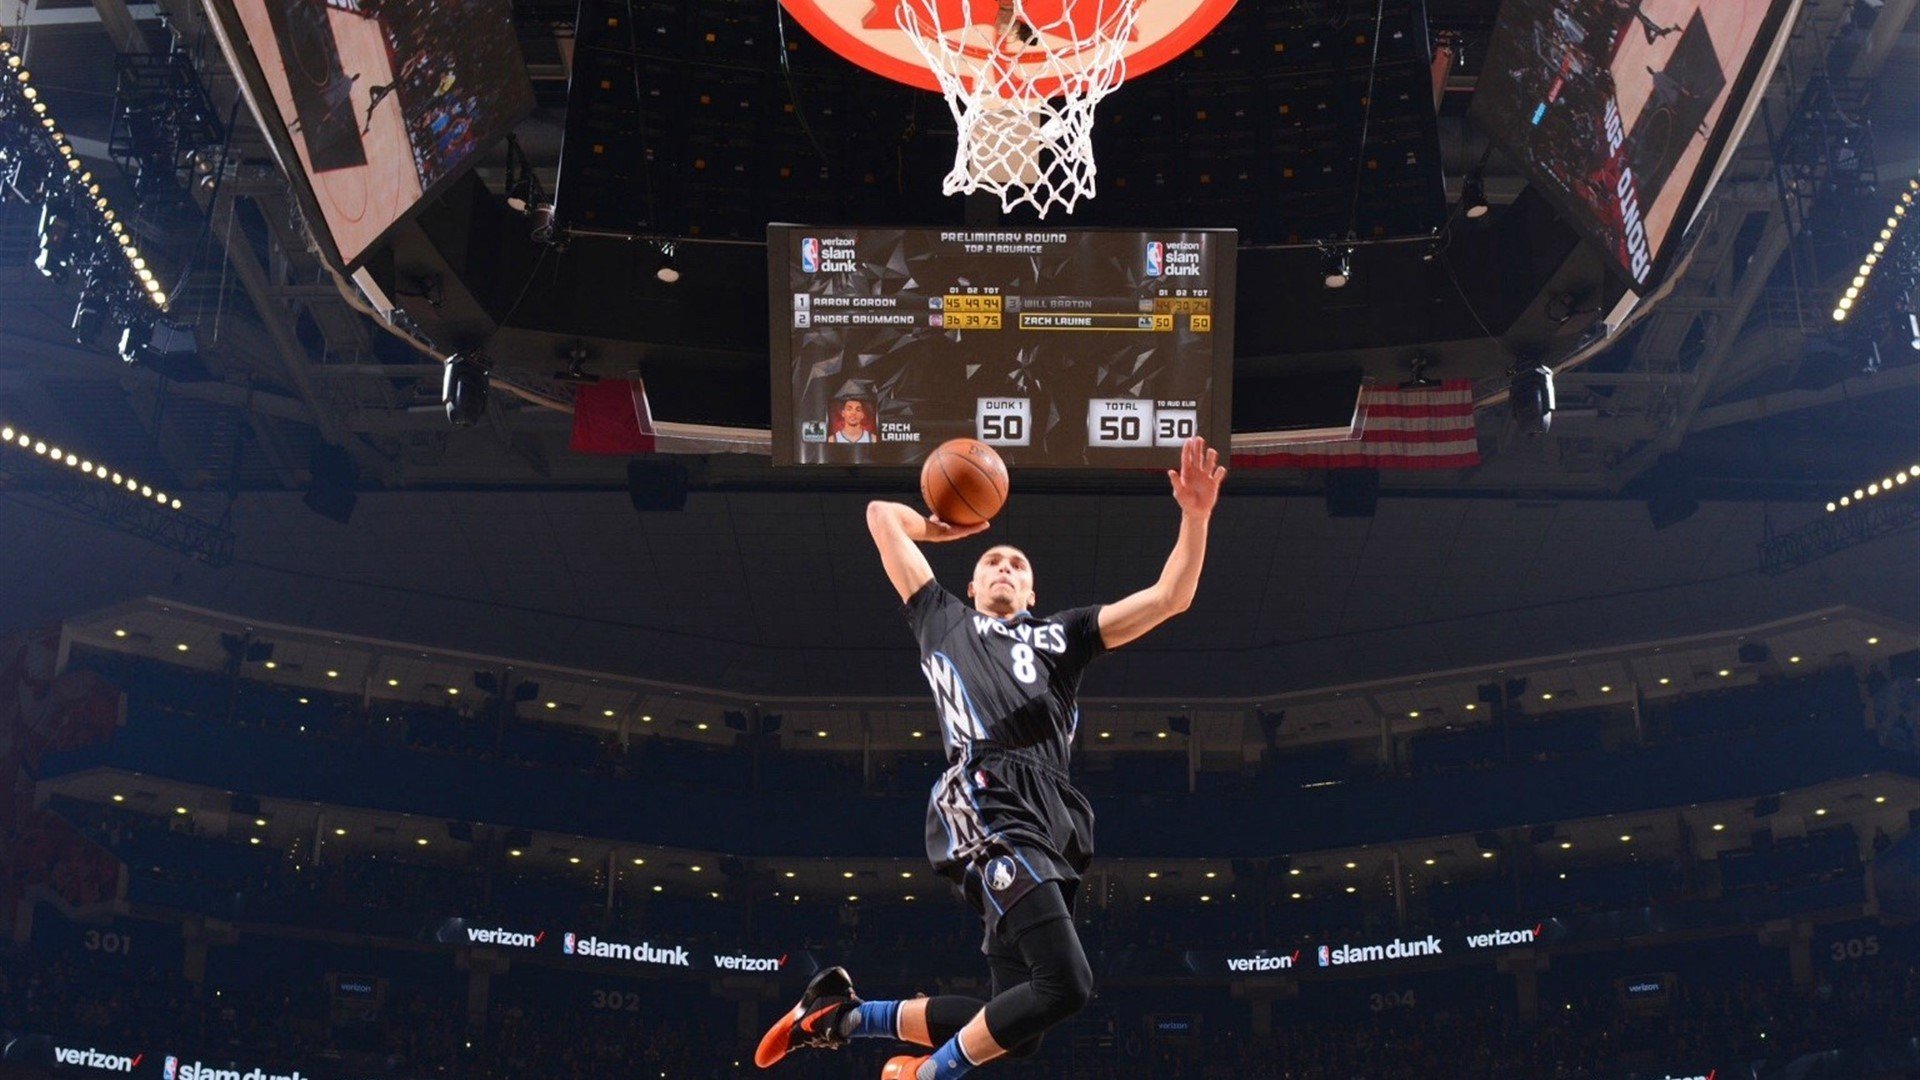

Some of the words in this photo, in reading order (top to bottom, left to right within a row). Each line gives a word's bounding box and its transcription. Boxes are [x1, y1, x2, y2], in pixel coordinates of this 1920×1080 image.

[821, 237, 855, 246] verizon
[941, 232, 1021, 242] PRELIMINARY
[1025, 233, 1067, 243] ROUND
[965, 244, 984, 253] TOP
[986, 245, 993, 253] 2
[996, 245, 1043, 253] ADVANCE
[1166, 241, 1199, 249] verizon
[821, 246, 855, 259] slam
[1166, 250, 1199, 263] slam
[821, 259, 857, 272] dunk
[1165, 263, 1200, 276] dunk
[813, 298, 850, 306] AARON
[853, 298, 896, 307] GORDON
[946, 299, 960, 308] 45
[965, 299, 979, 308] 49
[983, 299, 999, 308] 94
[1024, 300, 1047, 308] WILL
[1050, 300, 1092, 308] BARTON
[799, 315, 806, 324] 2
[813, 315, 849, 324] ANDRE
[852, 315, 914, 324] DRUMMOND
[966, 315, 979, 325] 39
[983, 316, 999, 325] 75
[1024, 317, 1052, 325] ZACH
[1055, 317, 1092, 326] LAVINE
[1156, 318, 1170, 327] 50
[1193, 318, 1208, 328] 50
[986, 401, 1015, 410] DUNK
[1018, 401, 1023, 409] 1
[1105, 402, 1138, 410] TOTAL
[881, 422, 911, 432] ZACH
[983, 415, 1023, 440] 50
[1100, 416, 1140, 441] 50
[1159, 418, 1193, 438] 30
[881, 432, 920, 442] LAVINE
[972, 615, 1067, 654] WOLVES
[1011, 643, 1037, 684] 8
[84, 930, 131, 955] 301
[467, 926, 535, 948] verizon
[1467, 927, 1534, 949] verizon
[577, 935, 630, 961] slam
[634, 943, 690, 967] dunk
[1331, 943, 1384, 965] slam
[1387, 934, 1442, 958] dunk
[1831, 935, 1881, 962] 305
[714, 953, 779, 972] verizon
[1227, 953, 1292, 972] verizon
[340, 983, 372, 993] verizon
[1628, 982, 1660, 994] verizon
[592, 989, 640, 1012] 302
[54, 1046, 132, 1073] verizon
[178, 1061, 240, 1080] slam
